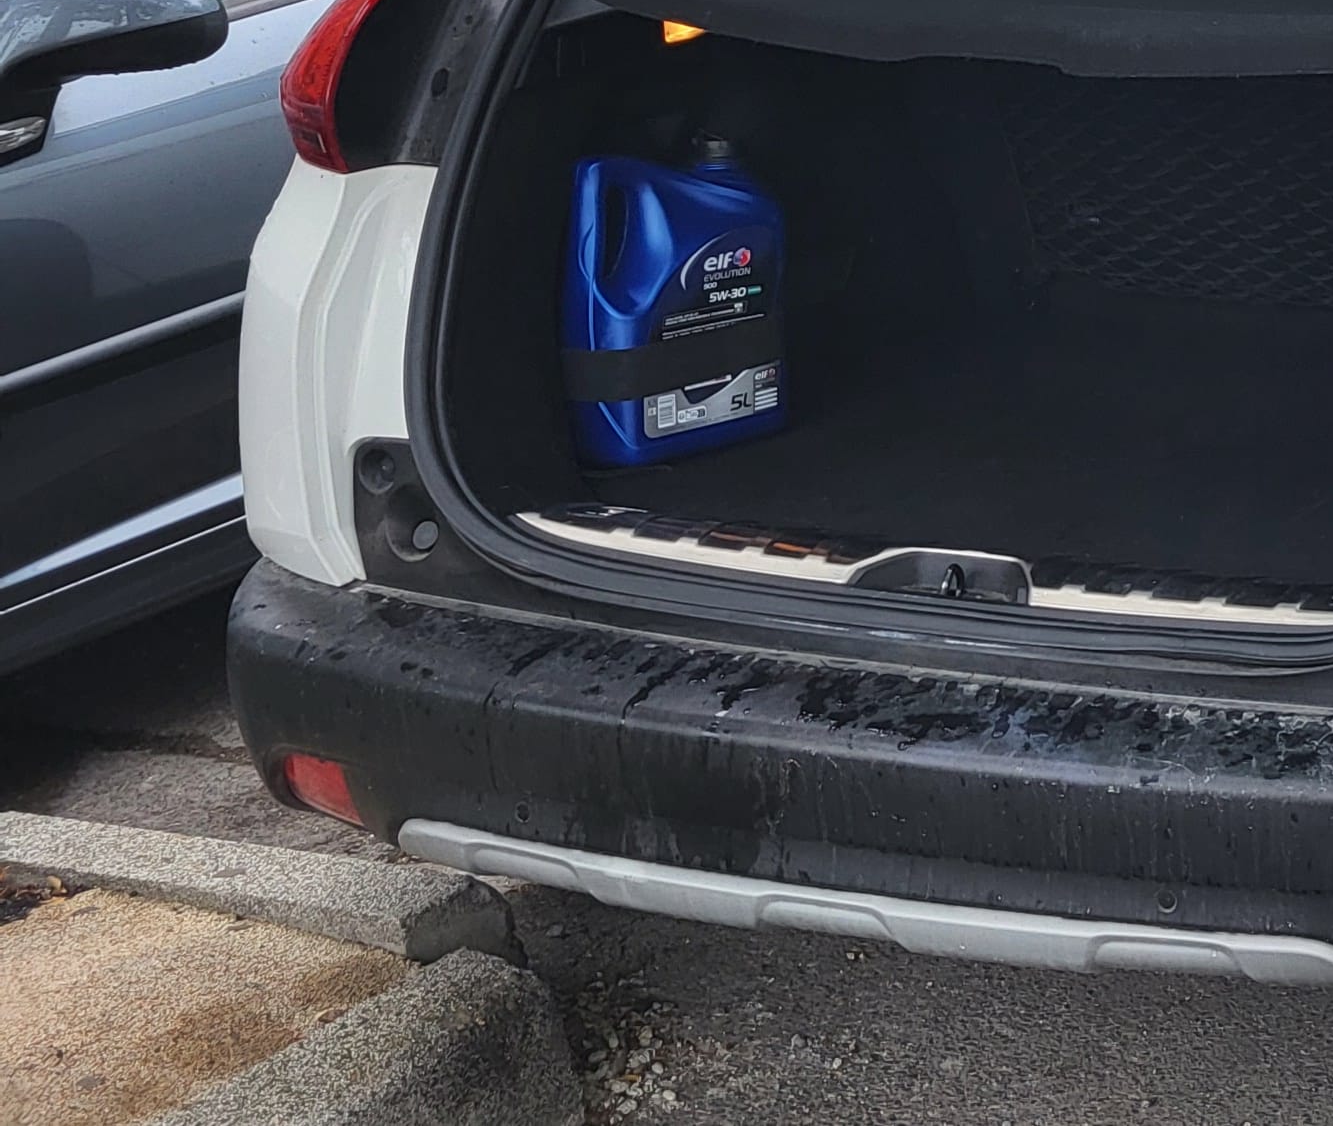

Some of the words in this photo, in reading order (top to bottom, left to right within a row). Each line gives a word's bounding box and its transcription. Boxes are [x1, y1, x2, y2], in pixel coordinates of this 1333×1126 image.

[703, 251, 734, 272] elf
[703, 266, 752, 283] EVOLUTION
[708, 286, 747, 303] 5W-30
[754, 370, 768, 380] elf
